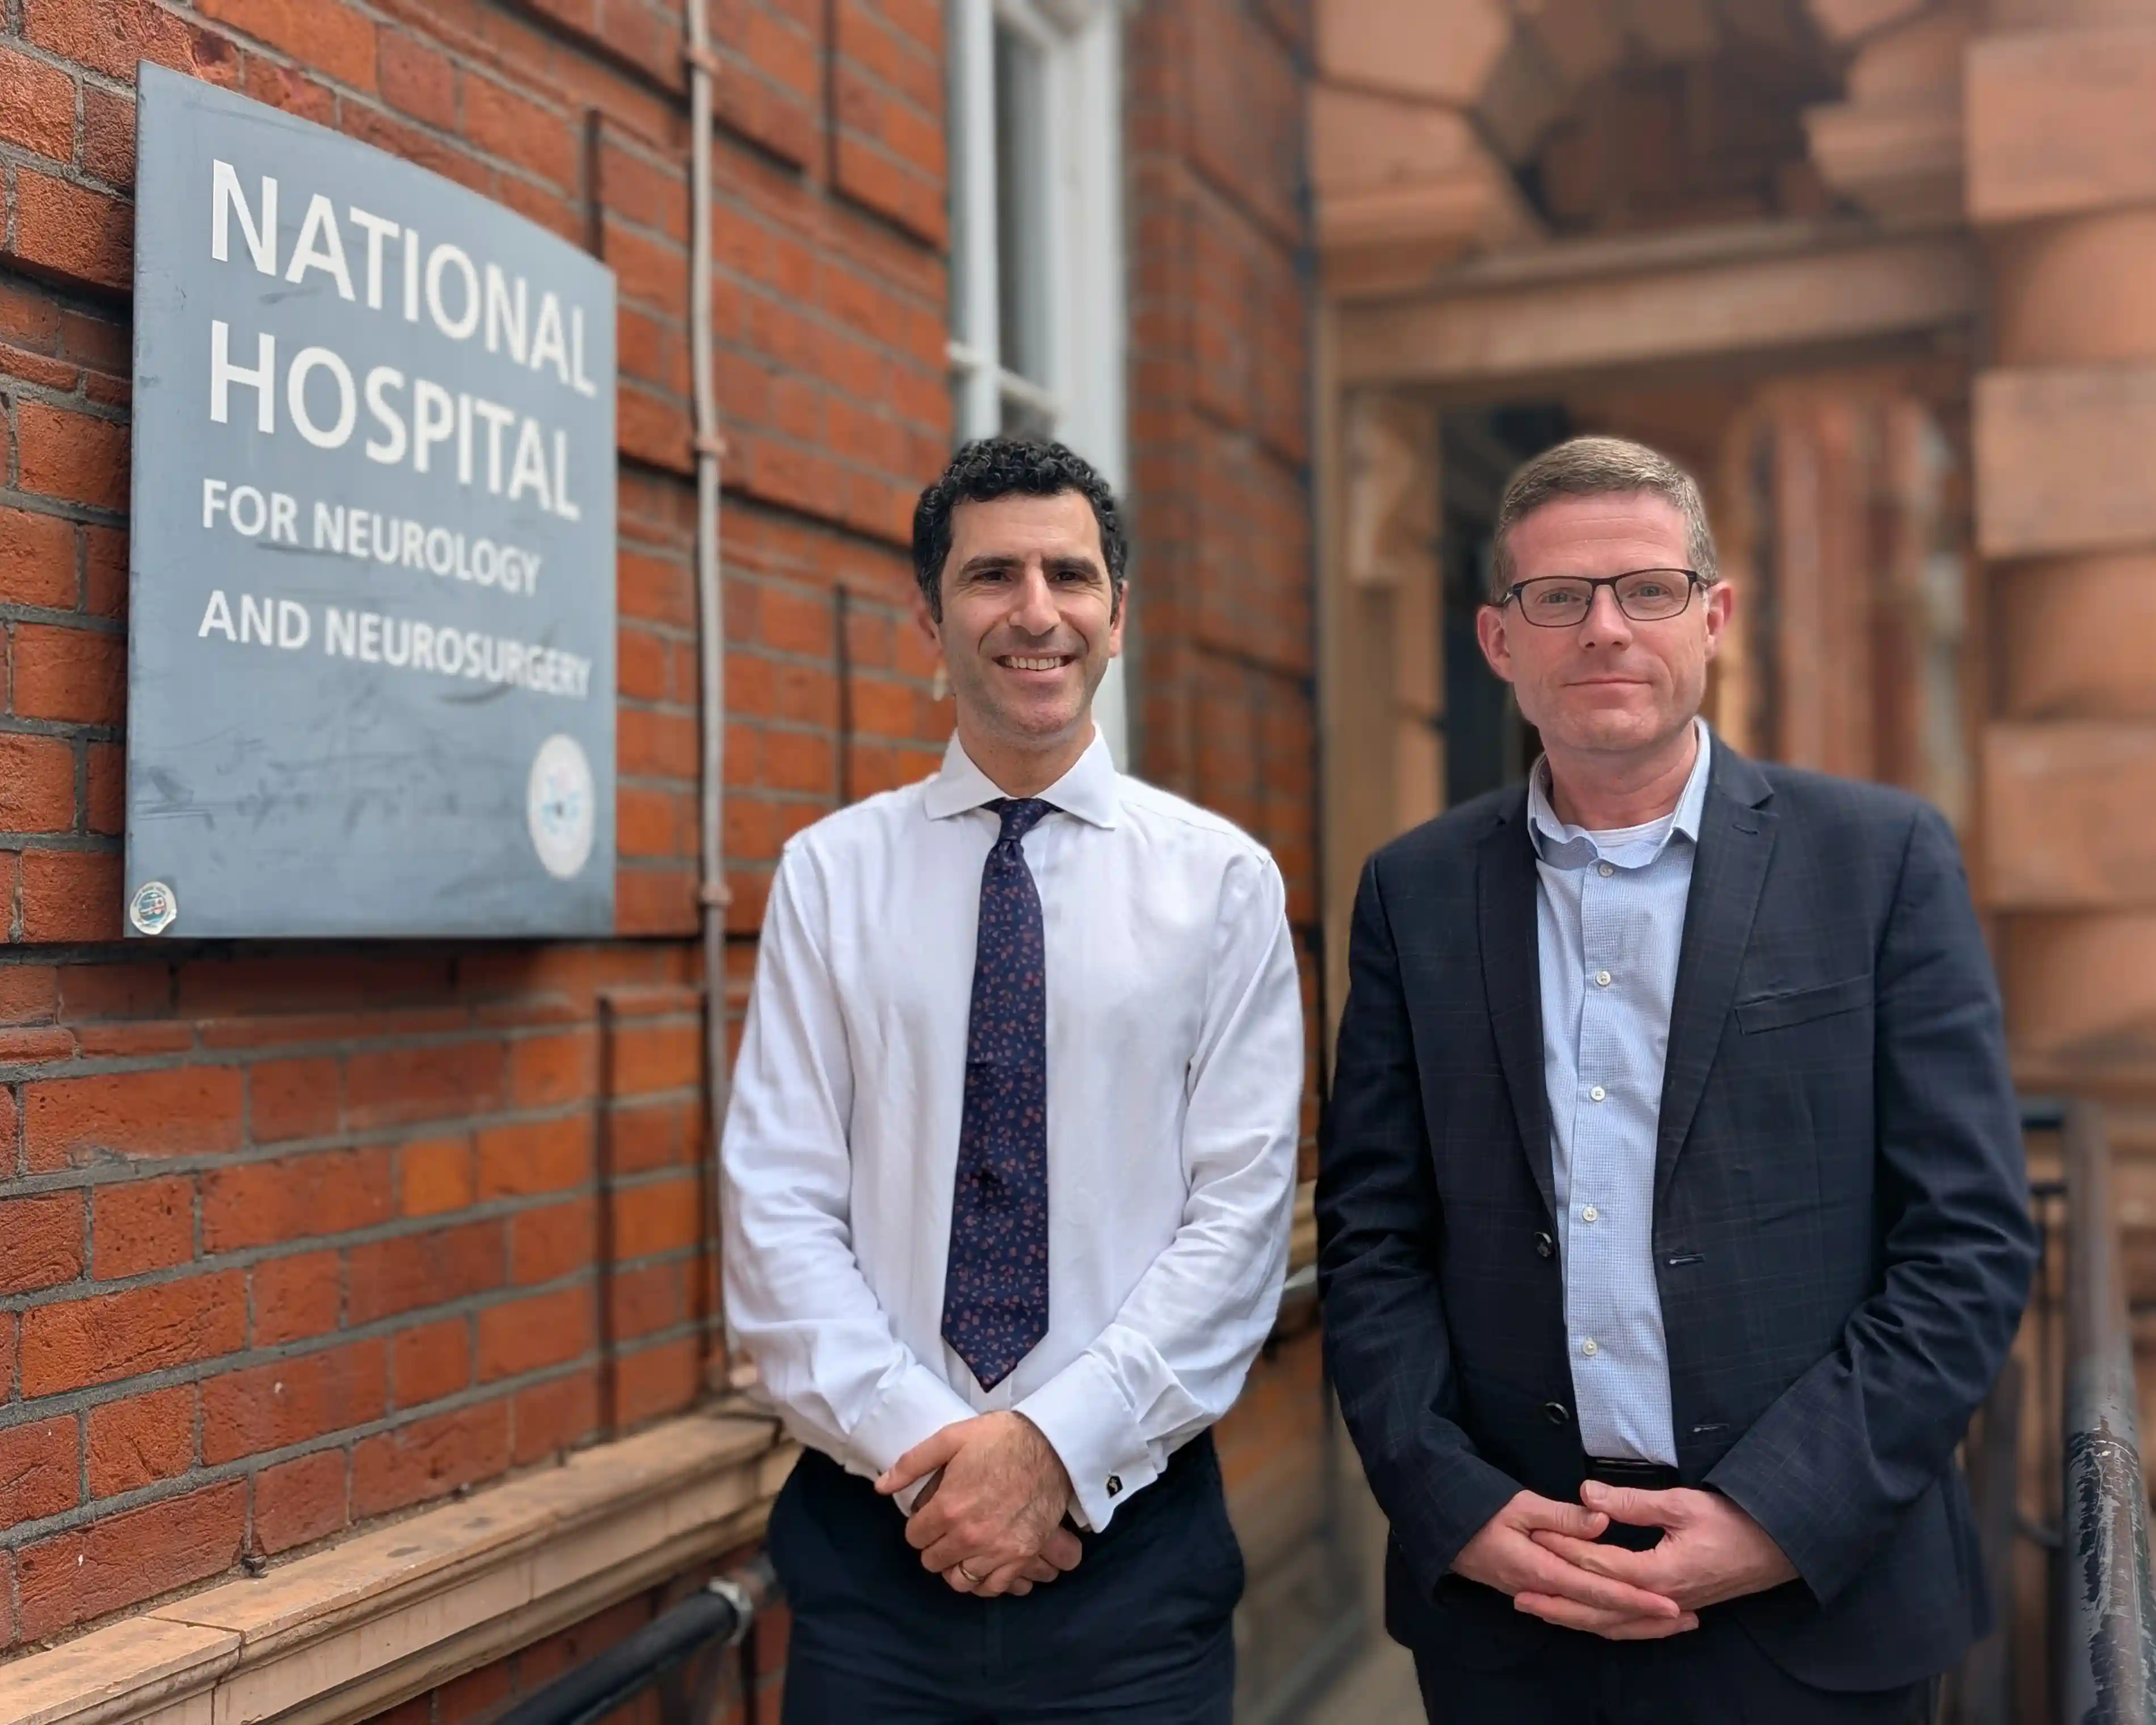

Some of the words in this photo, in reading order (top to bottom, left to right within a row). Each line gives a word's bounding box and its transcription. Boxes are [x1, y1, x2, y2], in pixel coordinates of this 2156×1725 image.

[212, 159, 597, 397] NATIONAL
[210, 319, 580, 521] HOSPITAL
[203, 478, 298, 543] FOR
[314, 500, 541, 596] NEUROLOGY
[199, 590, 310, 649] AND
[325, 606, 592, 699] NEUROSURGERY
